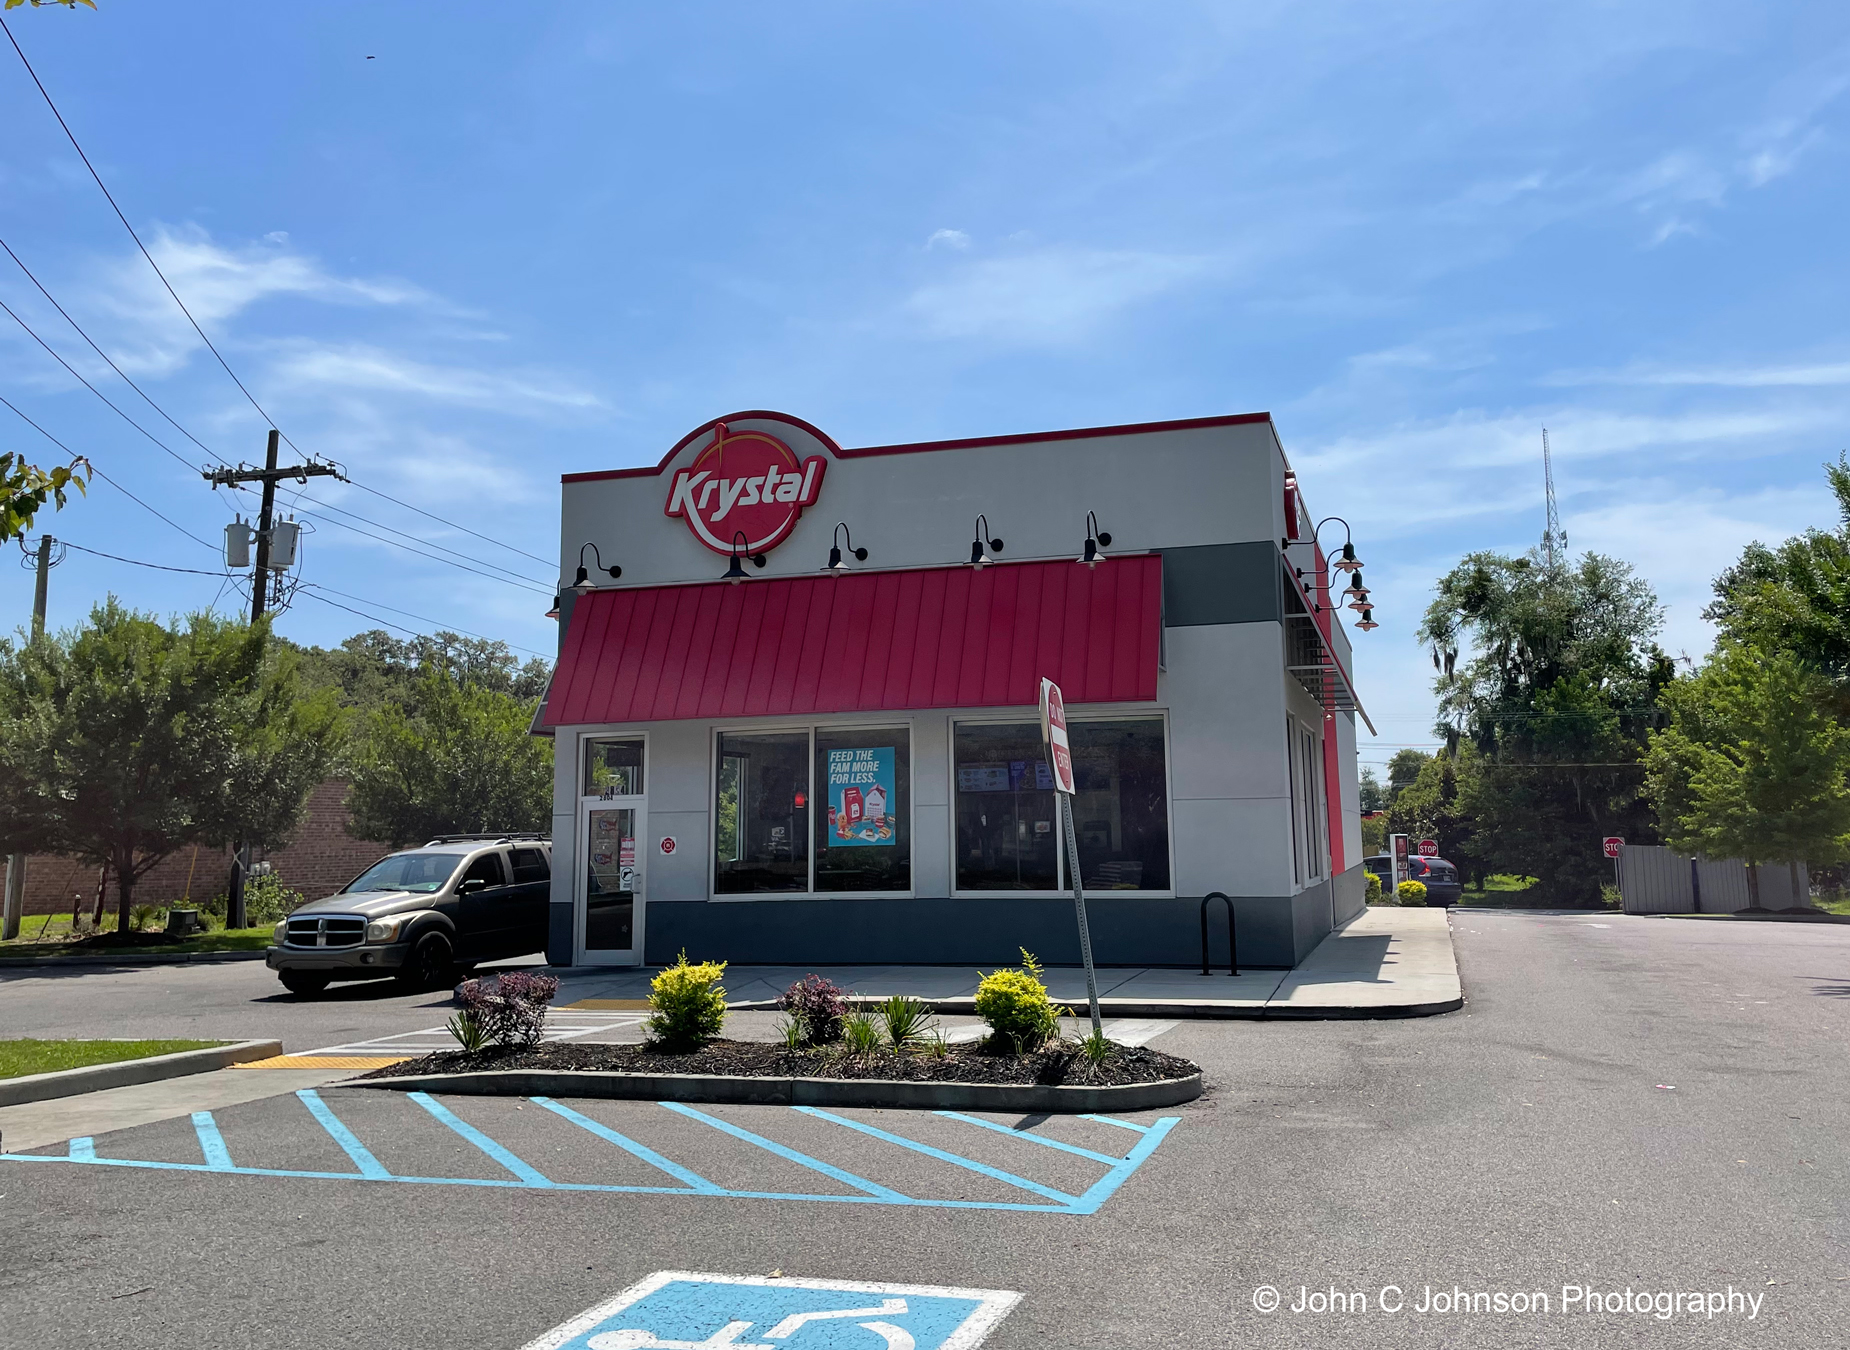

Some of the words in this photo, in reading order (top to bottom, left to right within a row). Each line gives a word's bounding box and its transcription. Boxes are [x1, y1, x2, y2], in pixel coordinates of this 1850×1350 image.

[668, 461, 818, 523] Krystal
[830, 751, 853, 762] FEED
[856, 750, 874, 761] THE
[1058, 751, 1070, 770] ENTER
[830, 762, 850, 773] FAM
[852, 761, 879, 772] MORE
[830, 774, 849, 784] FOR
[850, 773, 876, 784] LESS.
[1605, 843, 1618, 851] STO
